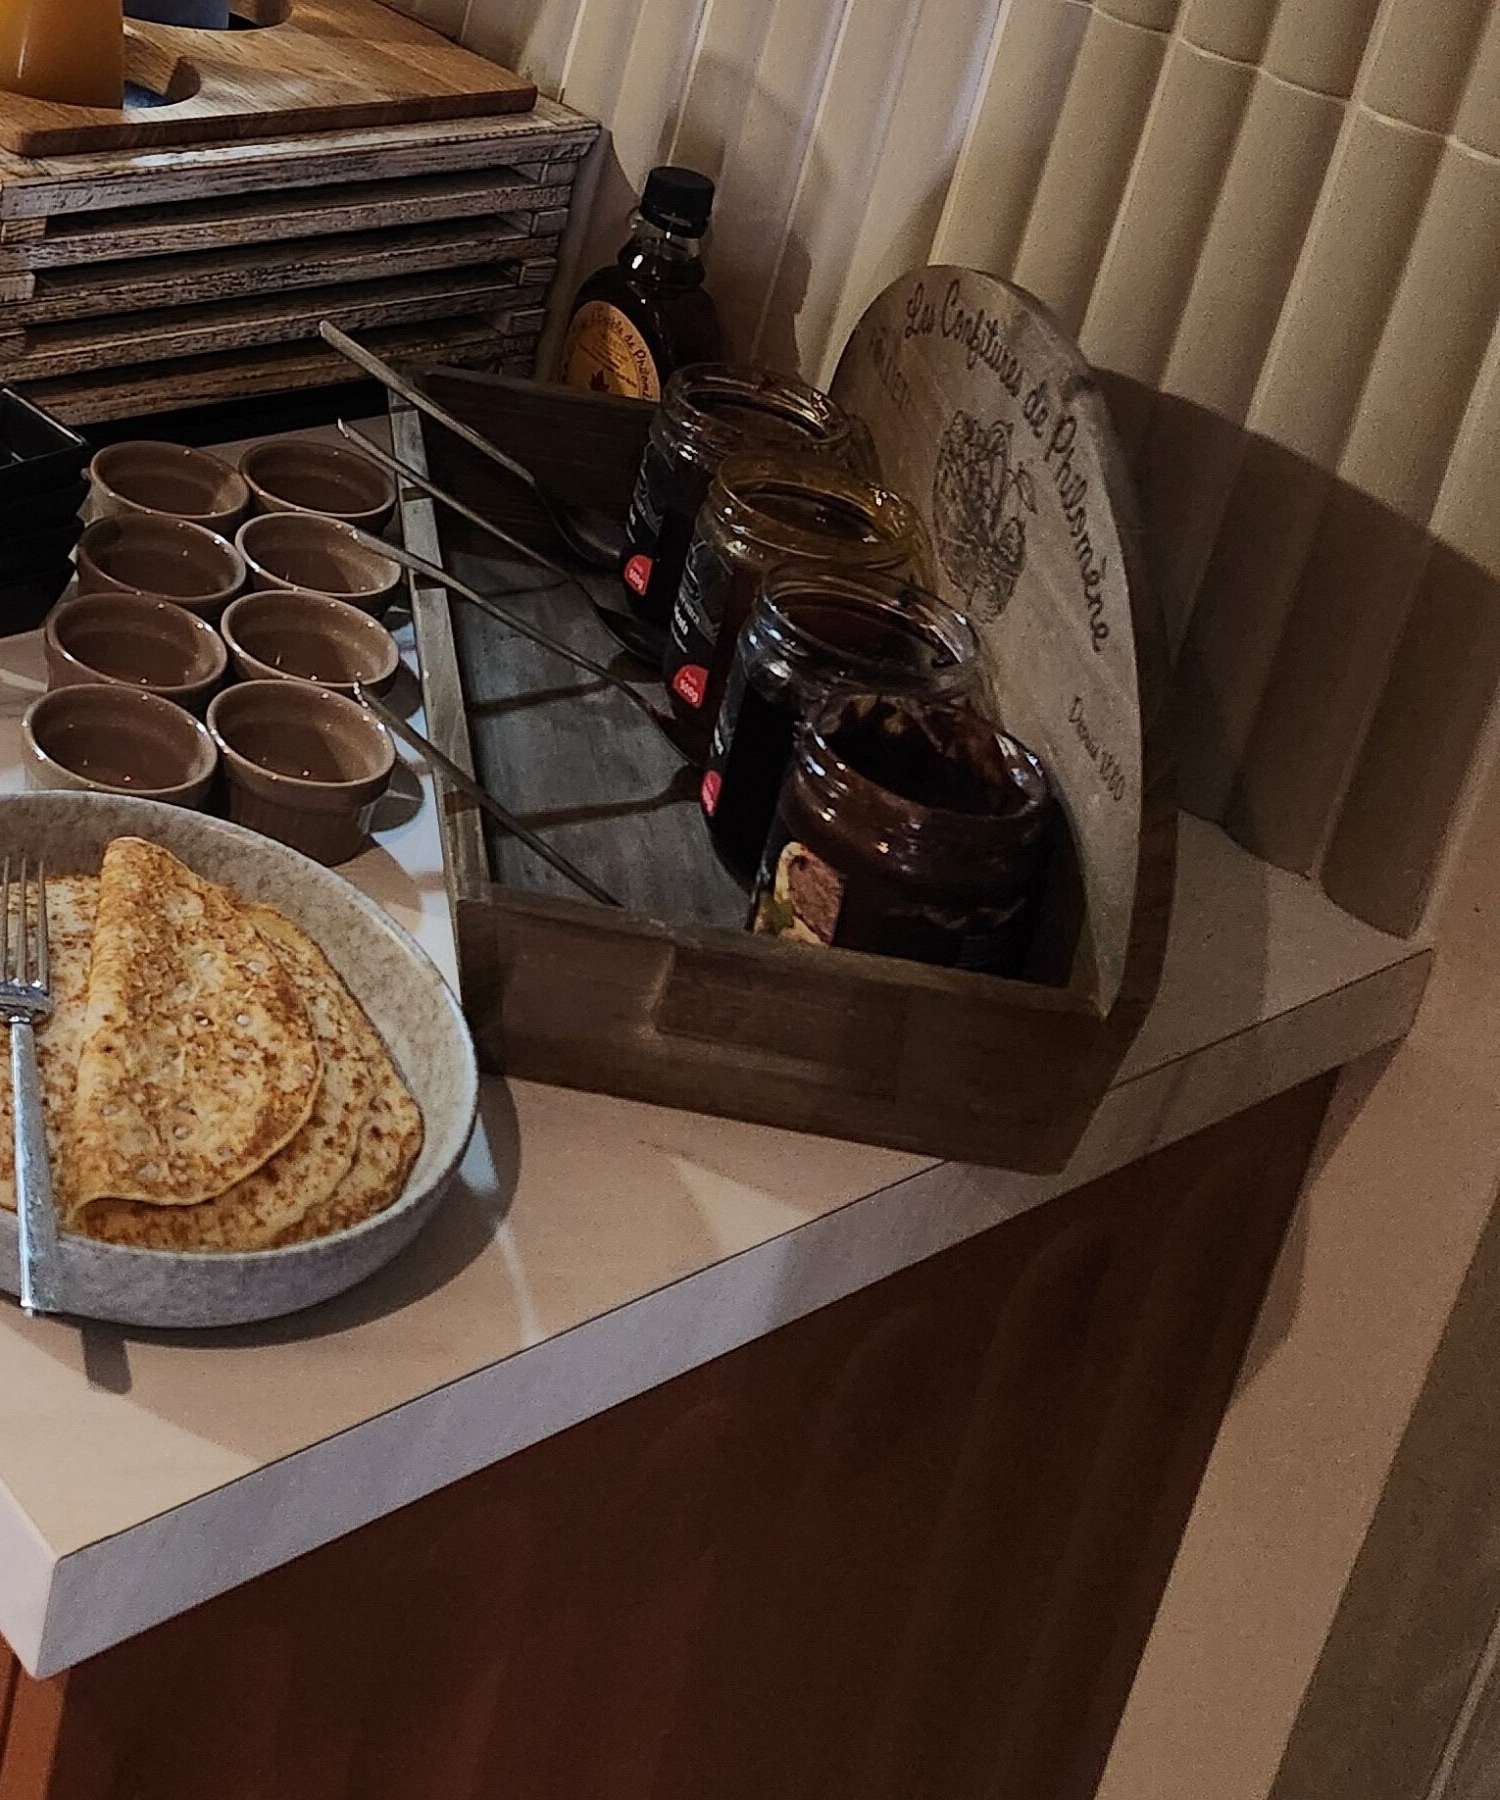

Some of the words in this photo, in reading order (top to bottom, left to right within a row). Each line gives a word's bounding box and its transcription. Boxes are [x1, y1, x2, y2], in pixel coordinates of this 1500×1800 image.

[904, 281, 936, 340] Les
[940, 278, 1025, 398] Confitures
[1022, 380, 1050, 439] de
